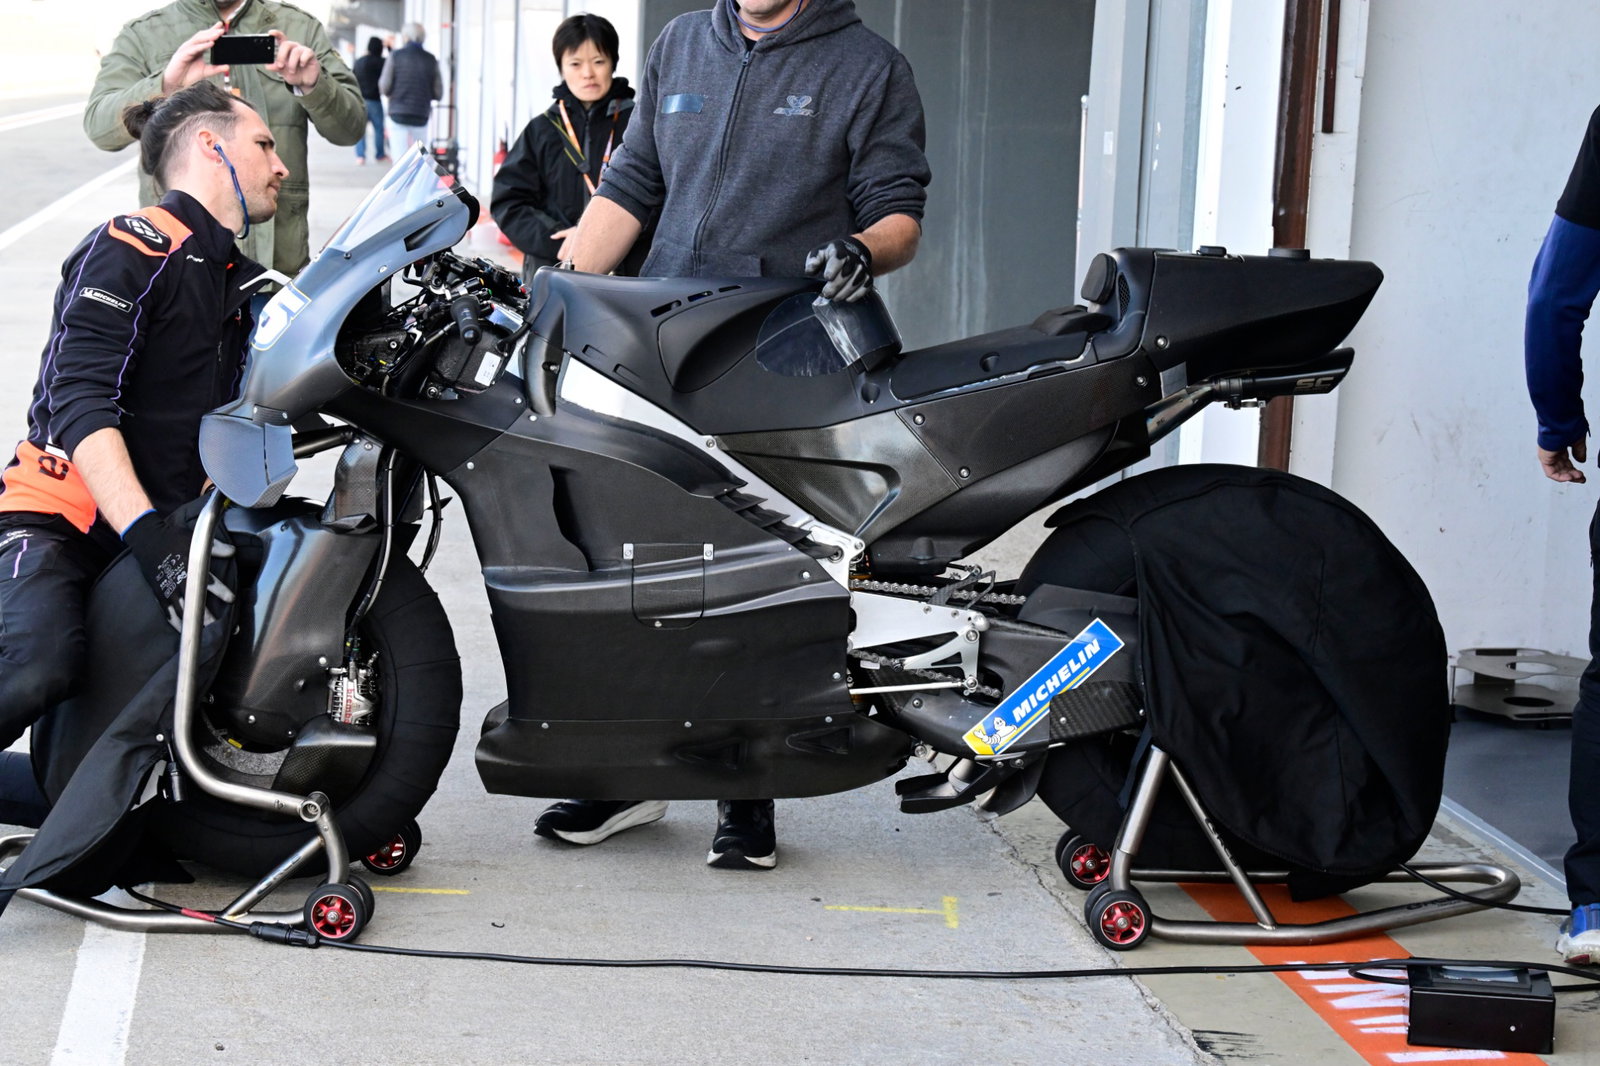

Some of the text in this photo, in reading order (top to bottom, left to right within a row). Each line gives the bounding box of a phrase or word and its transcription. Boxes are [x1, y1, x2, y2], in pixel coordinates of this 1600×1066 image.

[94, 291, 127, 309] MICHELIN
[252, 283, 309, 347] 5
[1296, 376, 1334, 388] SC
[1012, 639, 1101, 723] MICHELIN
